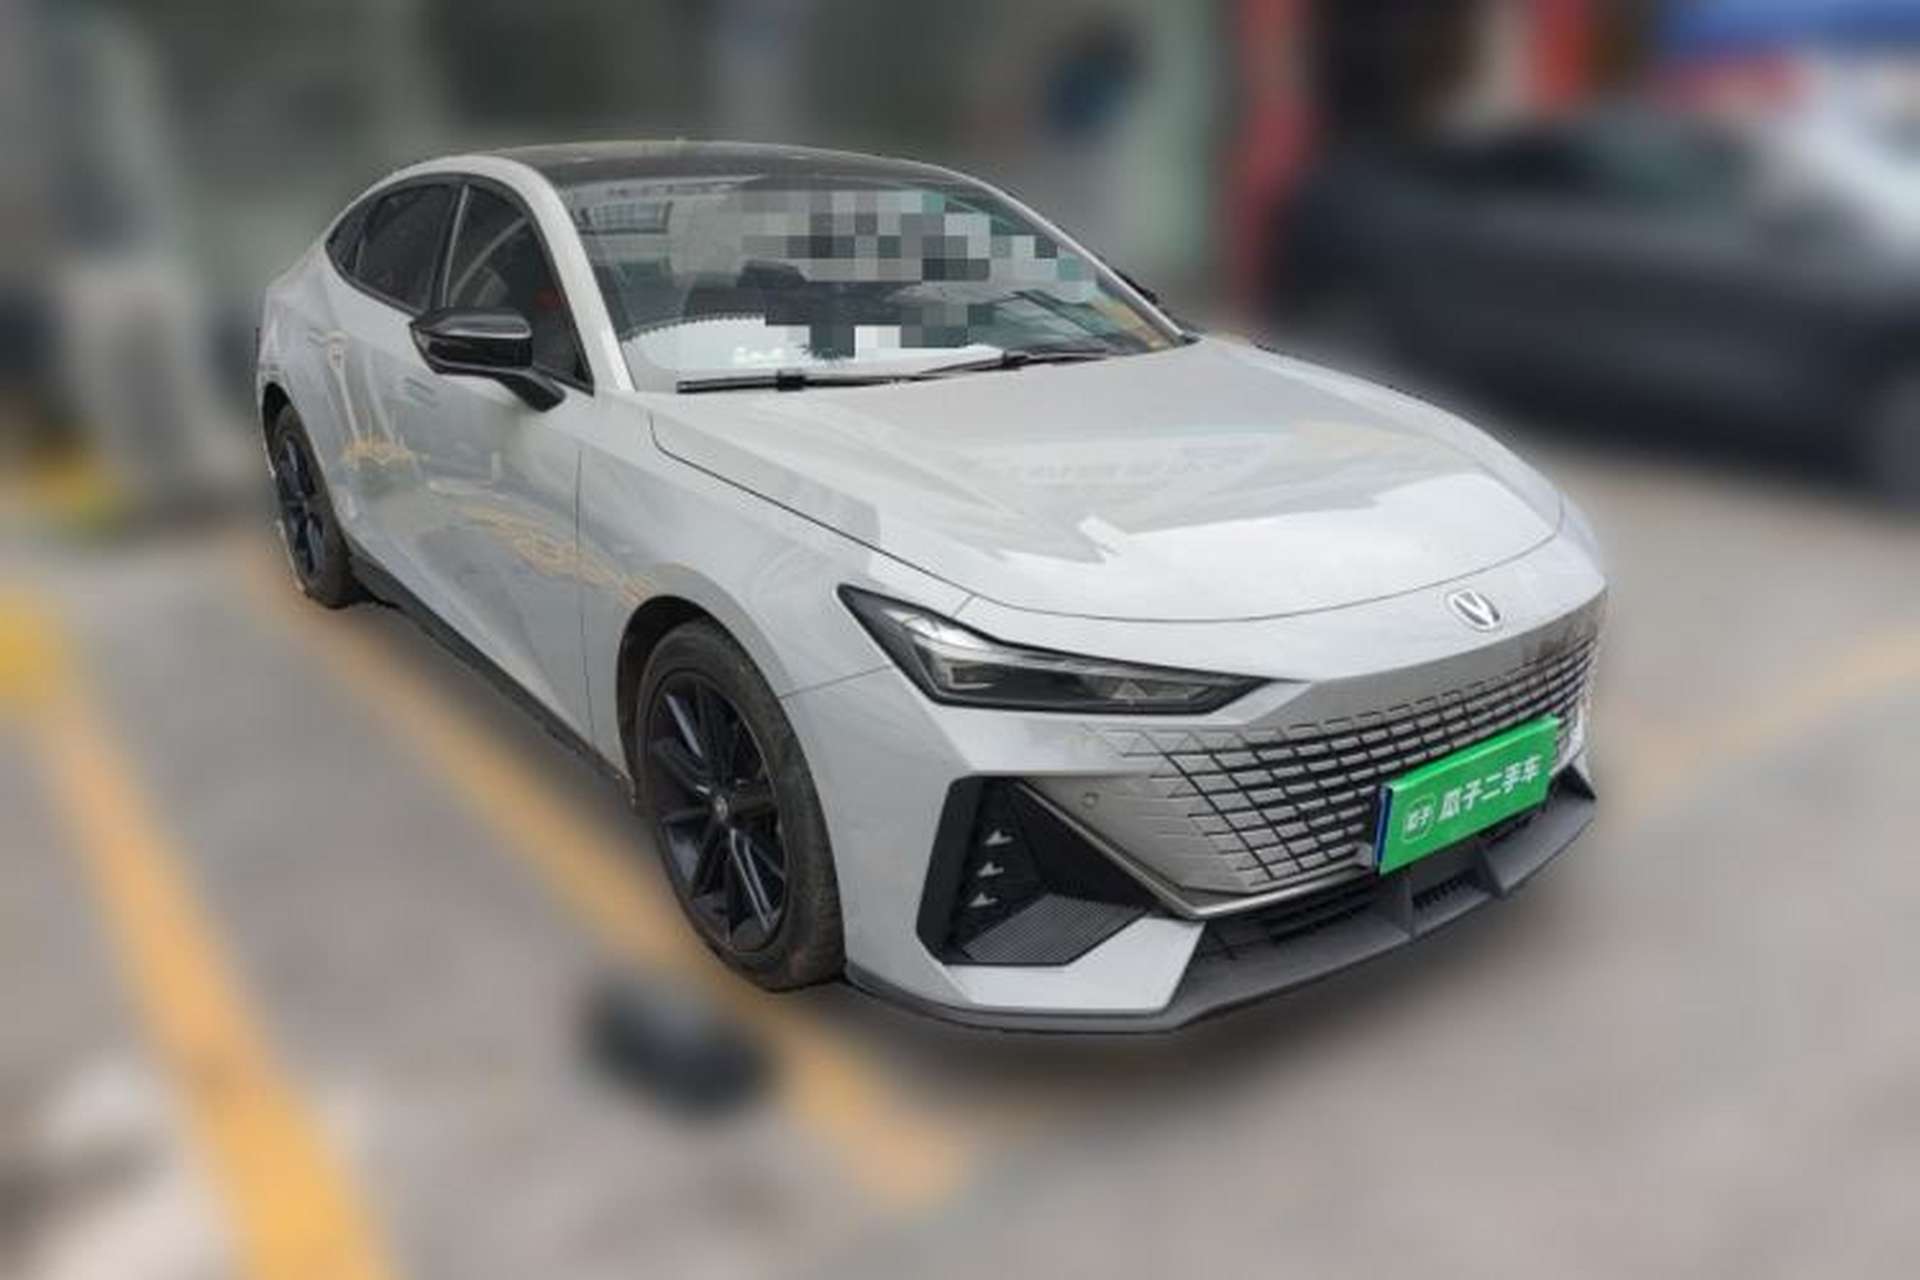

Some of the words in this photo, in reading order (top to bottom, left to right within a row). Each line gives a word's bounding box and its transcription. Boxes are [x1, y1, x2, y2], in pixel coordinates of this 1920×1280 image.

[1439, 755, 1542, 821] 瓜子二手车
